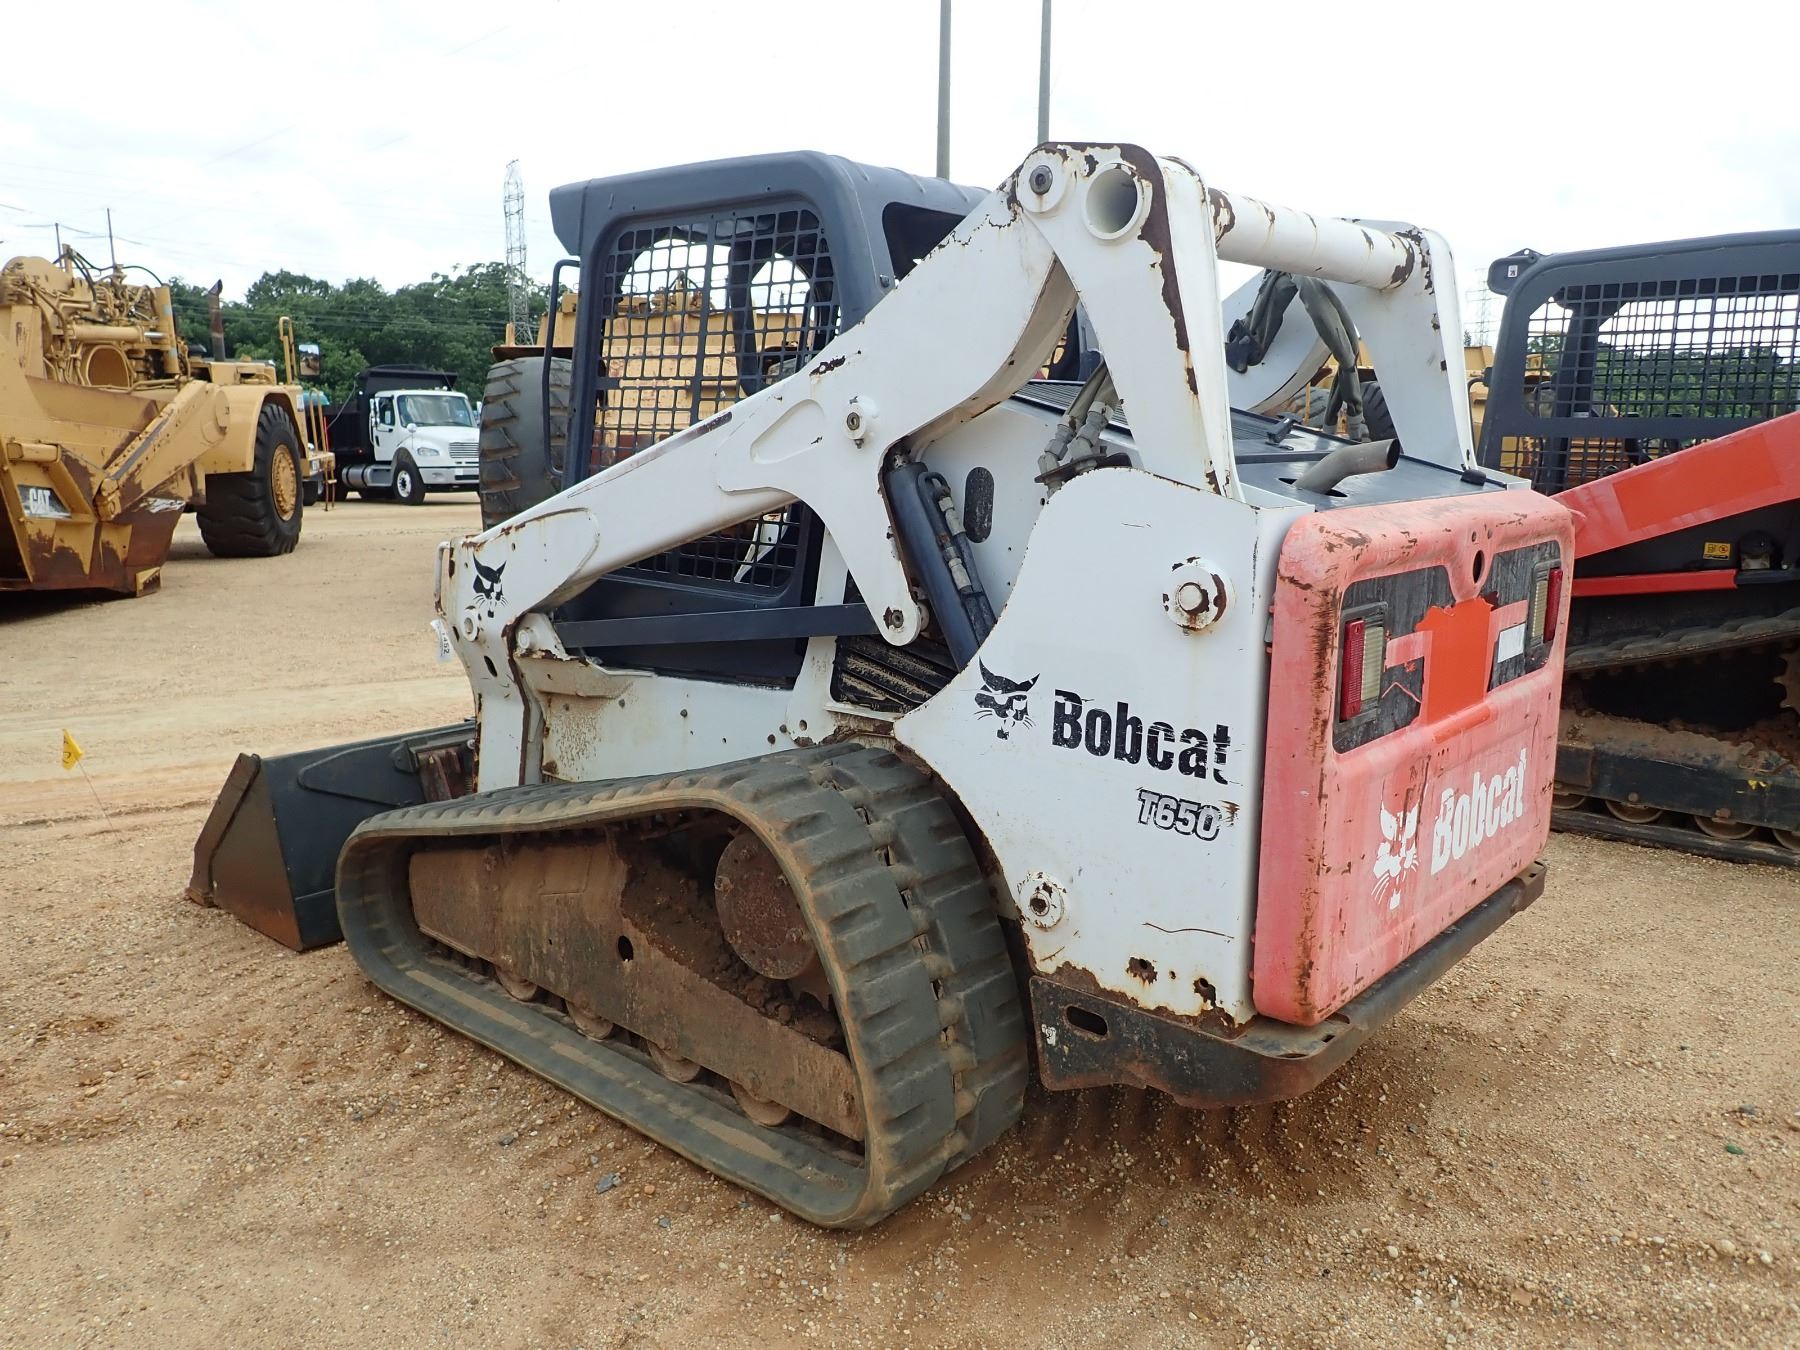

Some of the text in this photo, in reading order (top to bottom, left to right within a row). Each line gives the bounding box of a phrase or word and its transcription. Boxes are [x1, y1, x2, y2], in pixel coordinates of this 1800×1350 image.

[29, 488, 50, 514] CAT
[1051, 688, 1231, 786] Bobcat
[1137, 788, 1222, 842] T650
[1430, 747, 1527, 876] Bobcat
